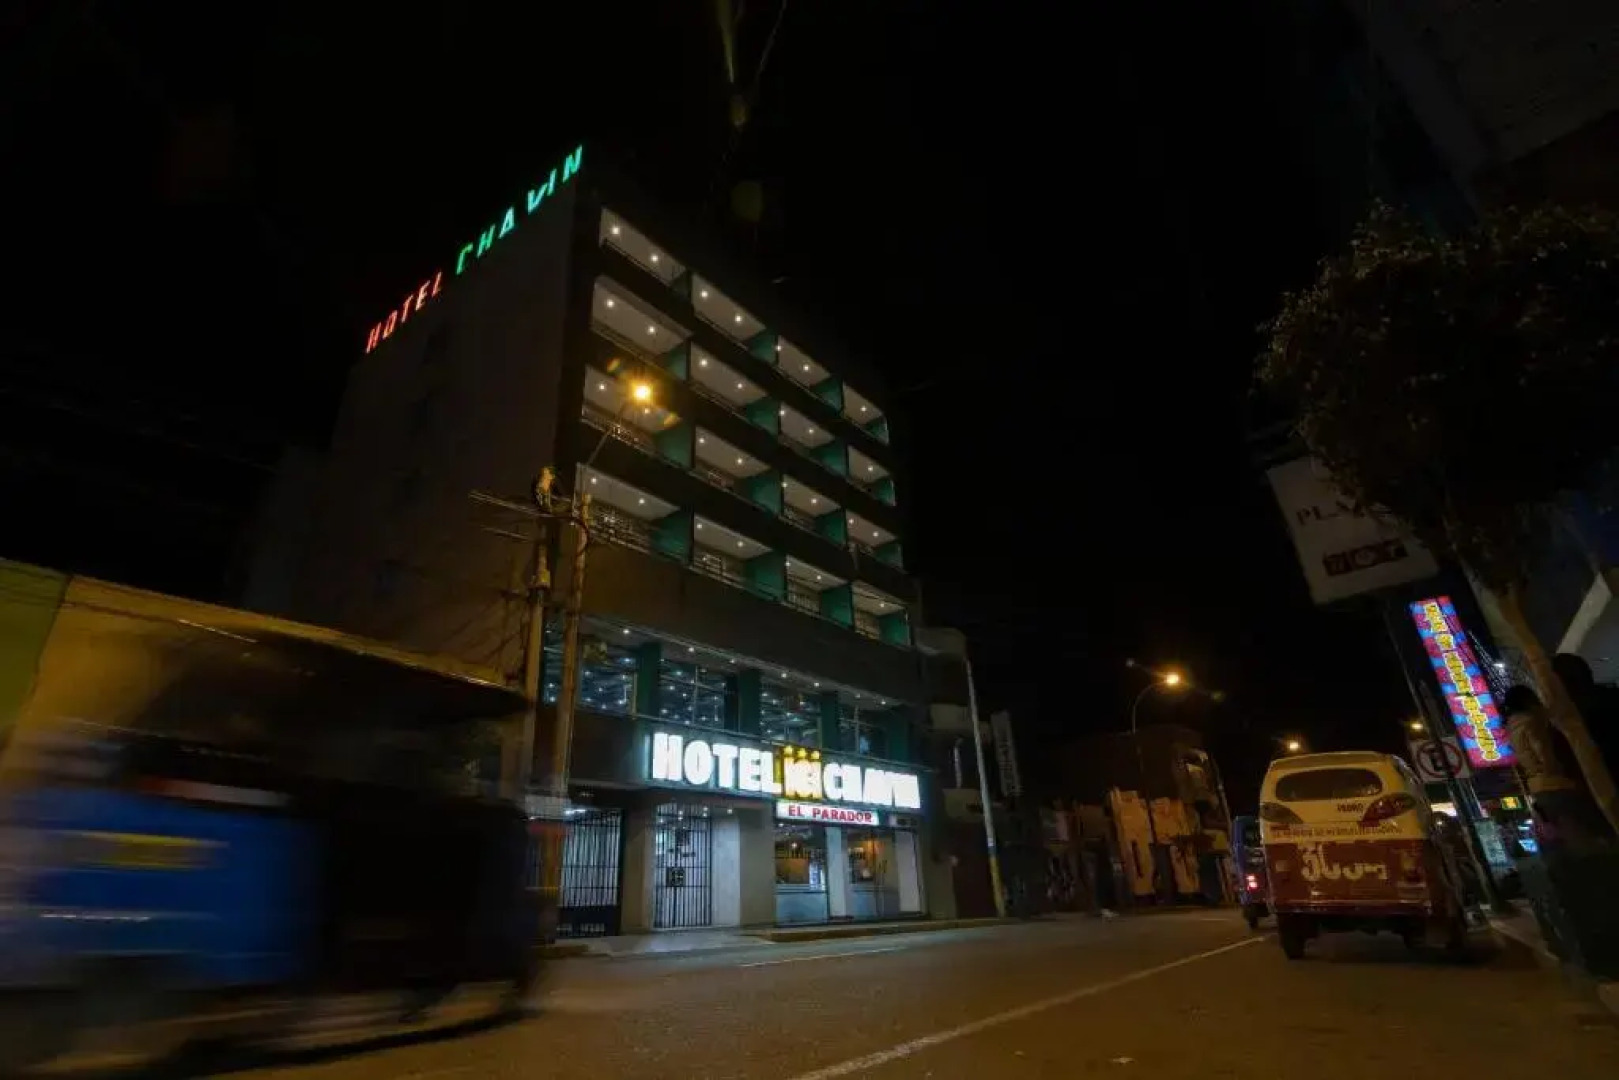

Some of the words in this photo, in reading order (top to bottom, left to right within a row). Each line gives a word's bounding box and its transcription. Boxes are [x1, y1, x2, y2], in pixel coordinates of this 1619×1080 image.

[365, 272, 442, 353] HOTEL
[652, 732, 783, 794] HOTEL
[788, 804, 805, 818] EL
[812, 807, 872, 824] PARADOR
